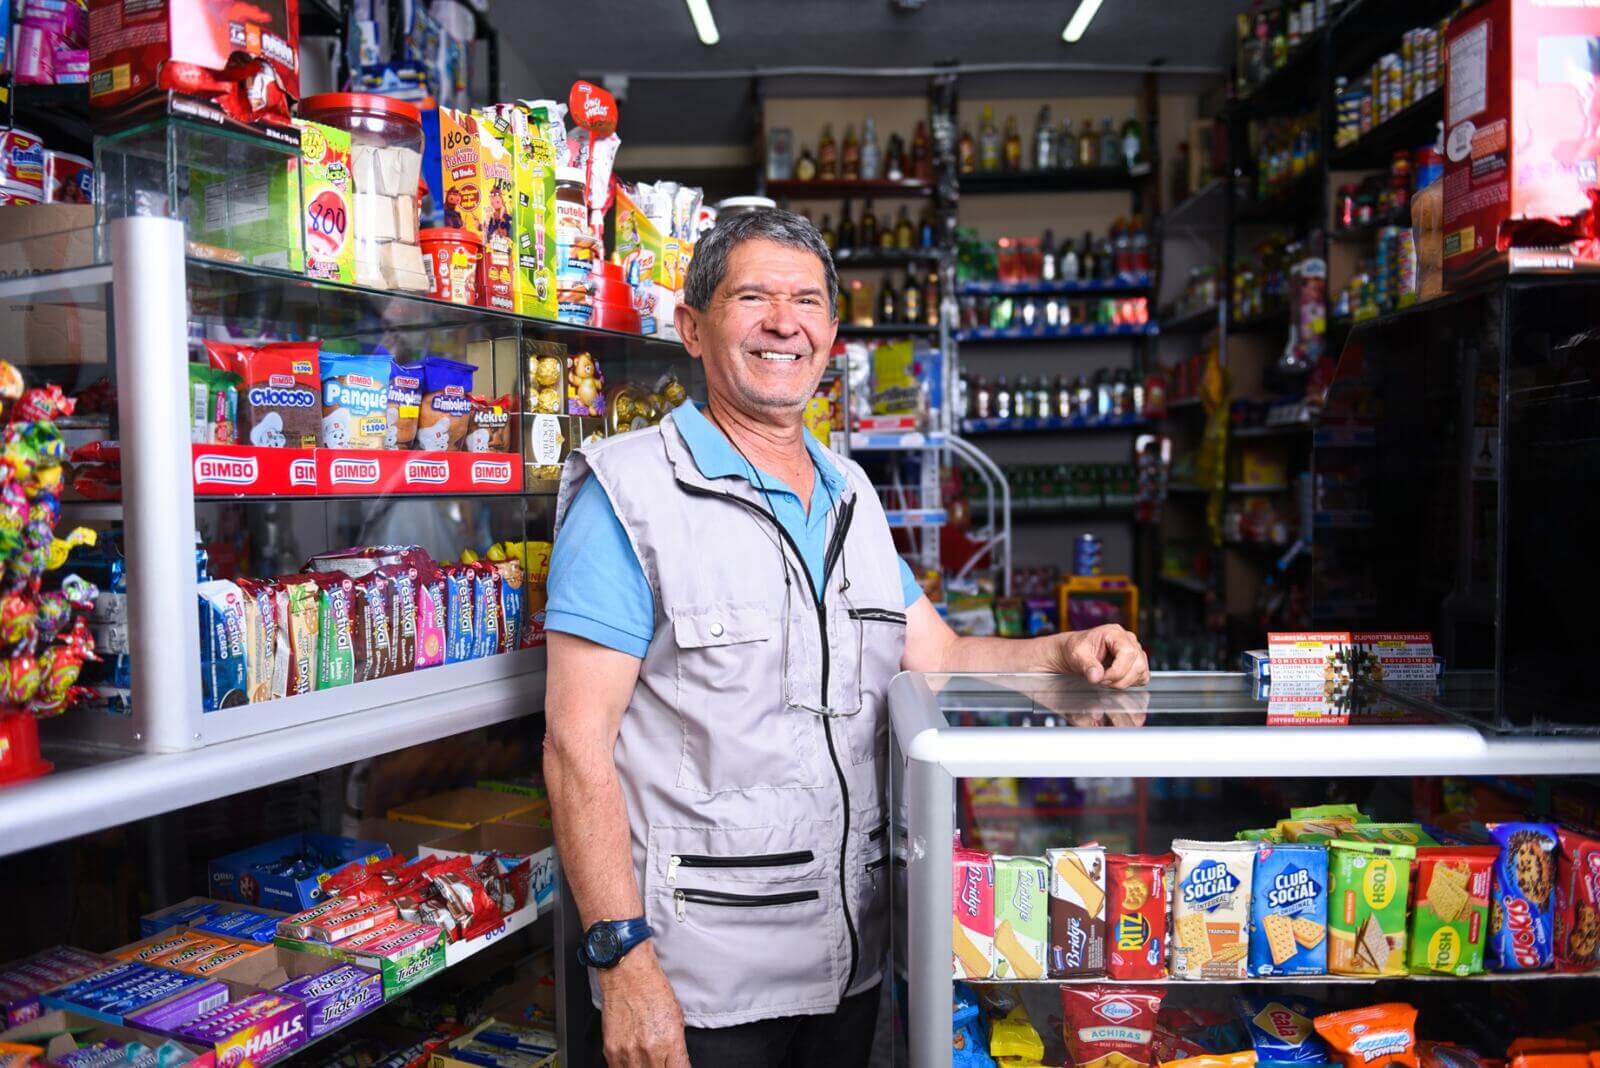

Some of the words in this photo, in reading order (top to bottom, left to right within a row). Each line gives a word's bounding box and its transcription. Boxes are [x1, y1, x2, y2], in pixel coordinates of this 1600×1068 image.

[308, 199, 346, 235] 800
[270, 376, 293, 384] BIMBO
[348, 375, 372, 385] BIMBO
[249, 387, 314, 406] CHOCOSO
[326, 383, 387, 411] Panqué
[200, 462, 254, 478] BIMBO
[334, 464, 376, 478] BIMBO
[408, 464, 446, 478] BIMBO
[475, 466, 509, 478] BIMBO
[369, 586, 388, 647] Festival
[400, 578, 414, 635] Festival
[432, 586, 445, 628] Festival
[457, 578, 470, 632] Festival
[484, 579, 497, 632] Festival
[224, 609, 243, 657] Festival
[260, 593, 274, 657] Festival
[331, 589, 350, 650] Festival
[216, 623, 228, 660] RECREO
[1192, 863, 1227, 884] CLUB
[1275, 869, 1309, 890] CLUB
[1372, 863, 1388, 903] TOSH
[965, 863, 982, 917] Bridge
[1017, 869, 1033, 922] Bridge
[298, 899, 345, 923] Trident
[328, 904, 379, 926] Trident
[1280, 899, 1314, 915] ORIGINAL
[352, 922, 397, 947] Trident
[379, 926, 428, 951] Trident
[1066, 917, 1083, 968] Bridge
[1117, 911, 1143, 951] RITZ
[1504, 896, 1540, 968] CHOKIS
[138, 935, 192, 960] Trident
[168, 942, 218, 966] Trident
[198, 949, 246, 973] Trident
[1436, 932, 1452, 969] TOSH
[306, 967, 357, 998] Trident
[397, 955, 434, 983] Trident
[139, 977, 188, 999] HALLS
[322, 988, 370, 1023] Trident
[1103, 1003, 1132, 1015] Ramo
[245, 1014, 304, 1058] HALLS
[1091, 1029, 1142, 1041] ACHIRAS
[1268, 1010, 1297, 1038] Gala
[1363, 1045, 1406, 1062] Brownie
